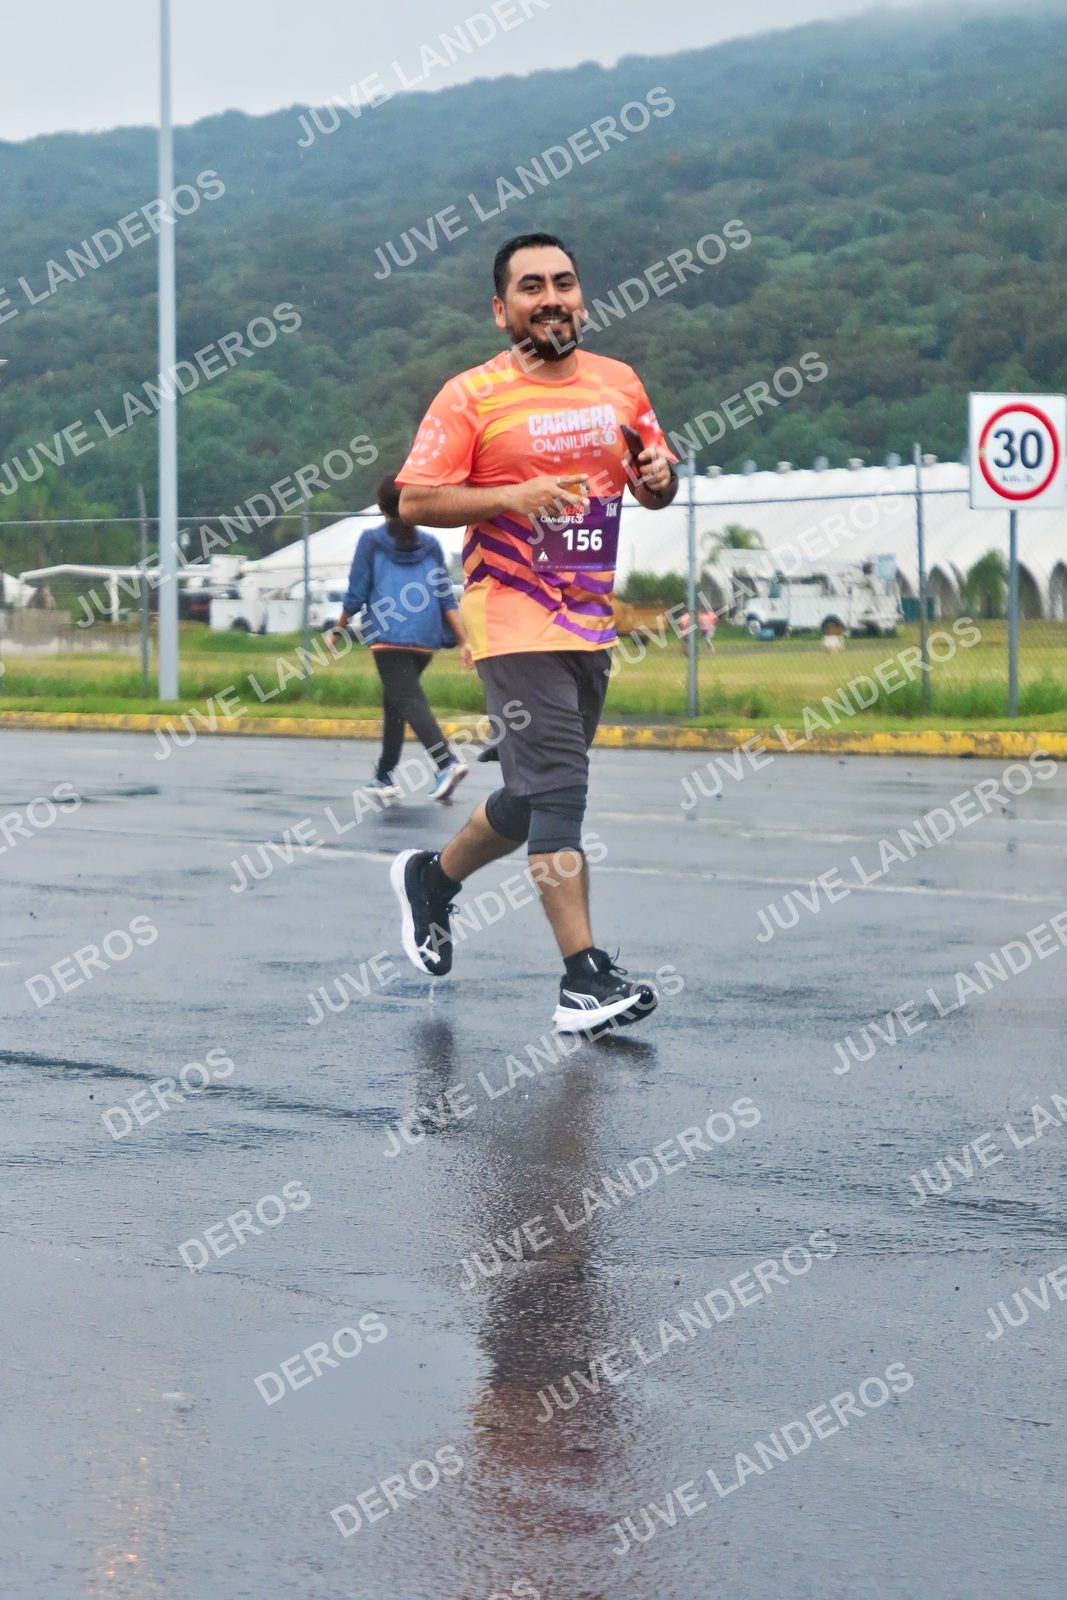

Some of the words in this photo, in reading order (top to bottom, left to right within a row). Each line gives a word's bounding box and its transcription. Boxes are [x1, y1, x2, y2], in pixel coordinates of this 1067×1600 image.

[528, 404, 615, 435] CARRERA
[532, 432, 600, 452] OMNILIFE
[994, 429, 1044, 469] 30
[562, 529, 603, 551] 156
